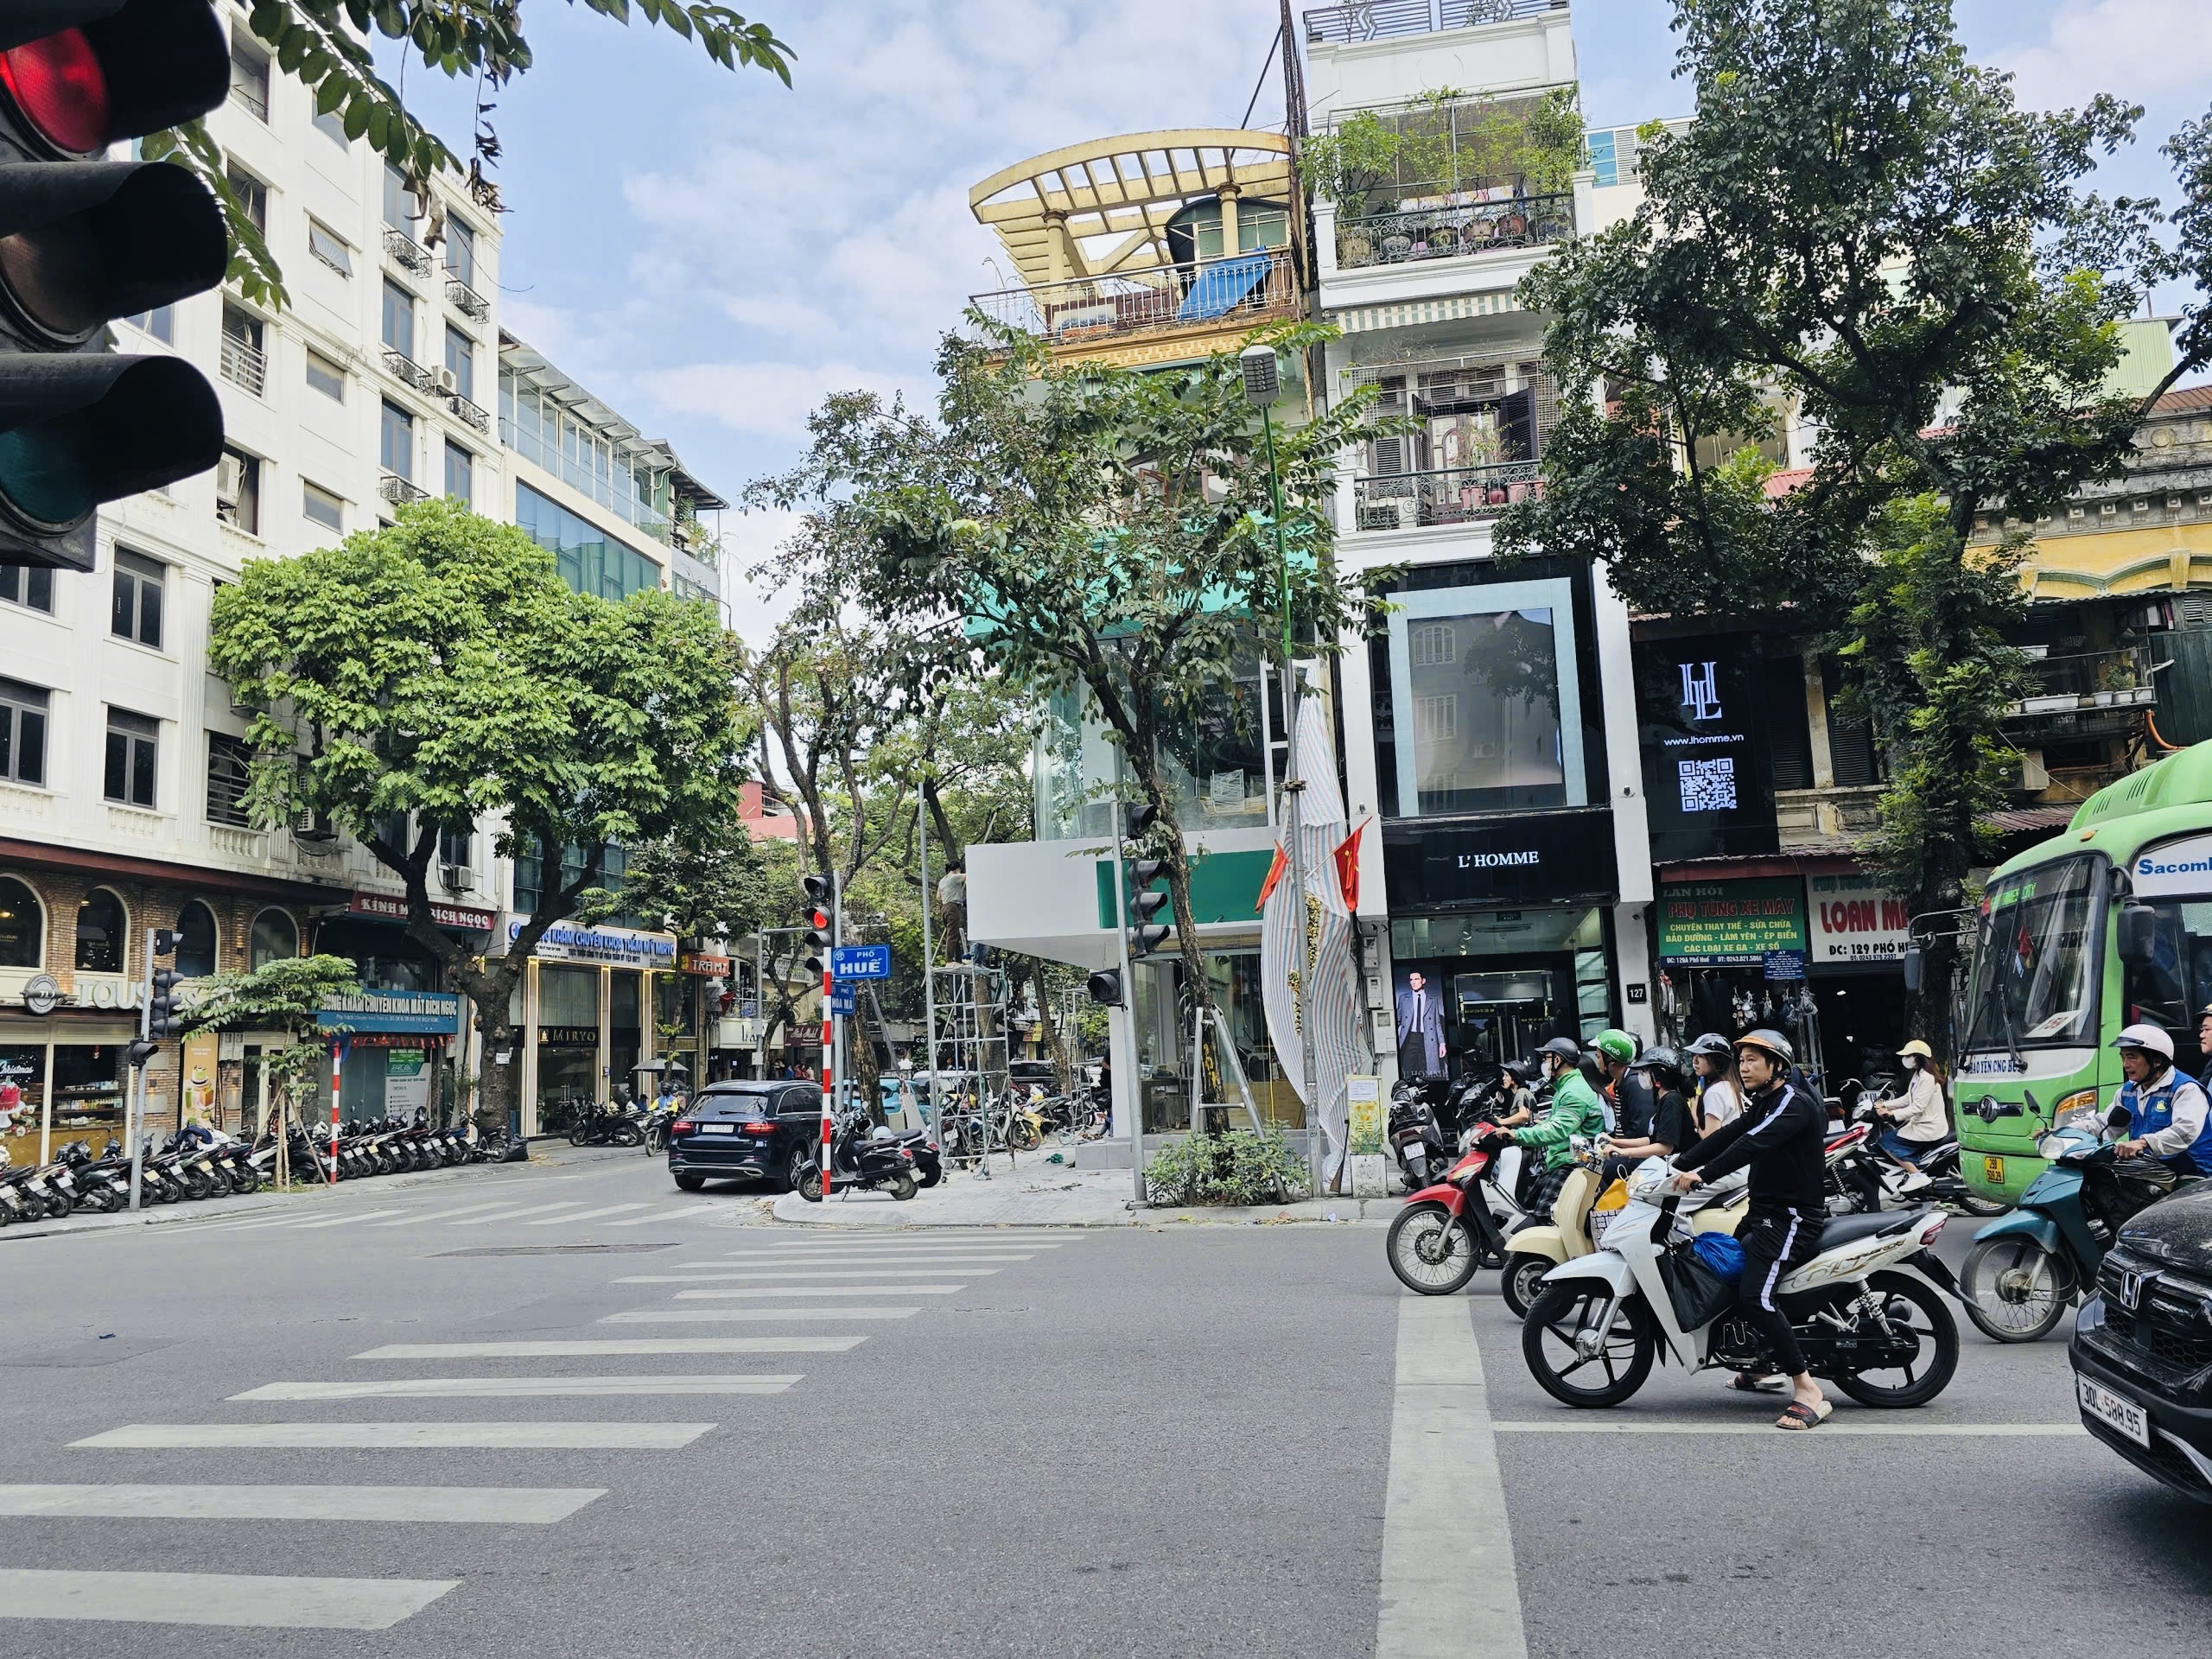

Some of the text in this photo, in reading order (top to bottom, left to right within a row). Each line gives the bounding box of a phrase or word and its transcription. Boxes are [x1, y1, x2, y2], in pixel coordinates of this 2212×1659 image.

[1473, 850, 1540, 868] HOMME
[2139, 856, 2212, 874] Sacom
[360, 897, 397, 913] KÍNH
[459, 912, 489, 929] NGỌC
[1740, 899, 1759, 916] XE
[1820, 899, 1878, 934] LOAN
[1669, 922, 1702, 932] CHUYÊN
[1704, 922, 1726, 931] THAY
[1719, 931, 1738, 940] LÀM
[654, 942, 674, 957] MIRYO
[857, 950, 875, 958] PHỐ
[1684, 944, 1701, 952] CÁC
[1702, 944, 1721, 953] LOẠI
[1829, 944, 1847, 956] ĐC:
[1851, 944, 1870, 955] 129
[839, 957, 883, 975] HUẾ
[1630, 988, 1643, 998] 127
[391, 997, 410, 1014] KHOA
[441, 1000, 457, 1020] NGỌC
[1605, 1043, 1621, 1056] Grab
[1993, 1059, 2007, 1072] CNG
